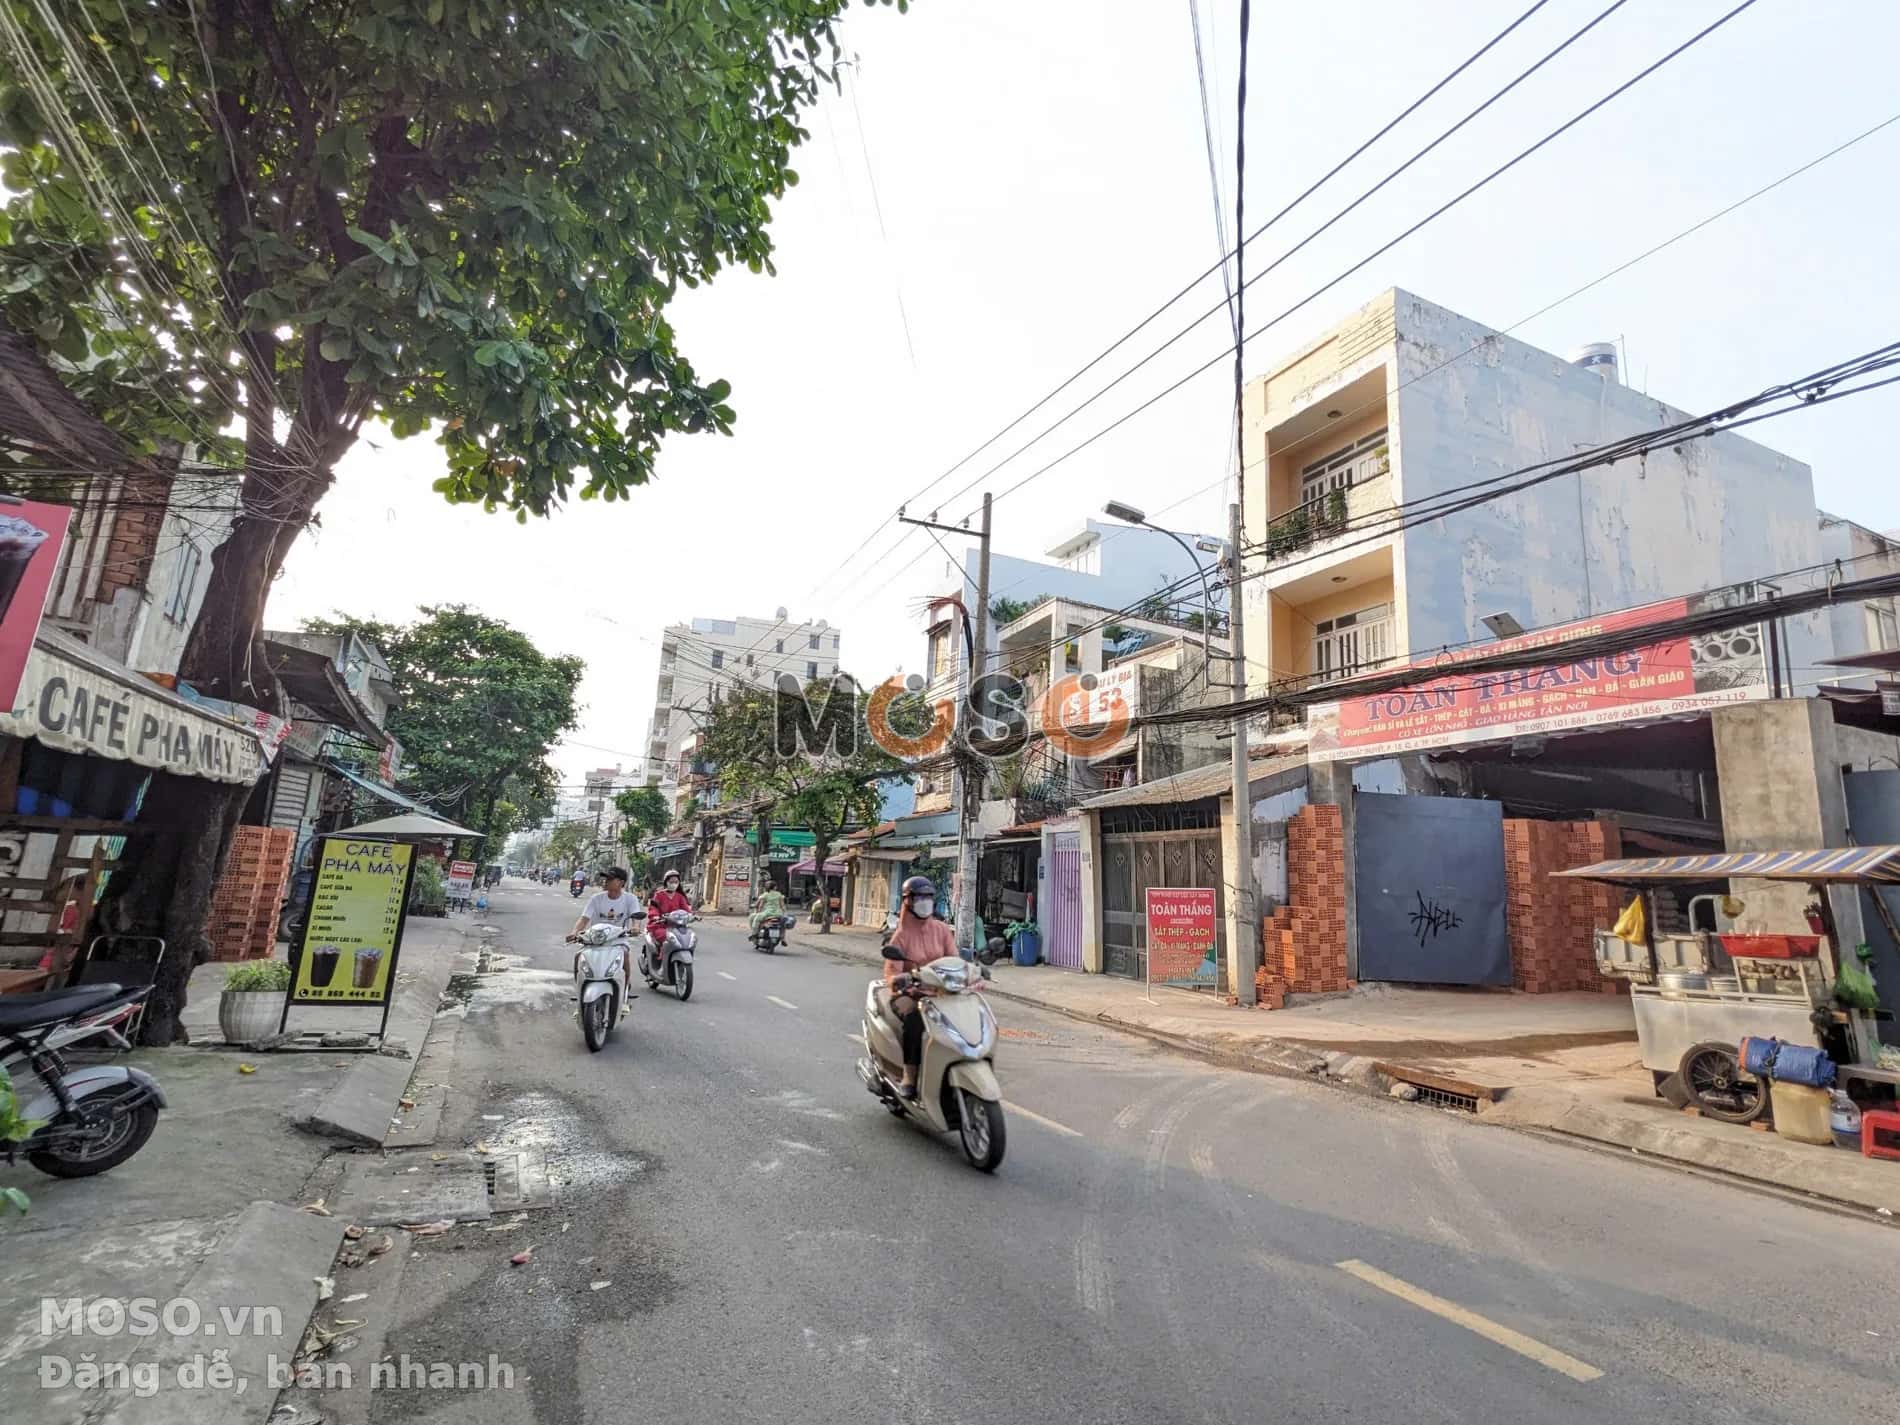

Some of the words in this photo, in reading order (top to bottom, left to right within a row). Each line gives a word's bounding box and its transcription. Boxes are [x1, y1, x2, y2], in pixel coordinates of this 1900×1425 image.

[1099, 687, 1122, 712] 53
[38, 677, 131, 750] CAFÉ
[136, 712, 191, 765] PHA
[323, 857, 361, 873] PHA
